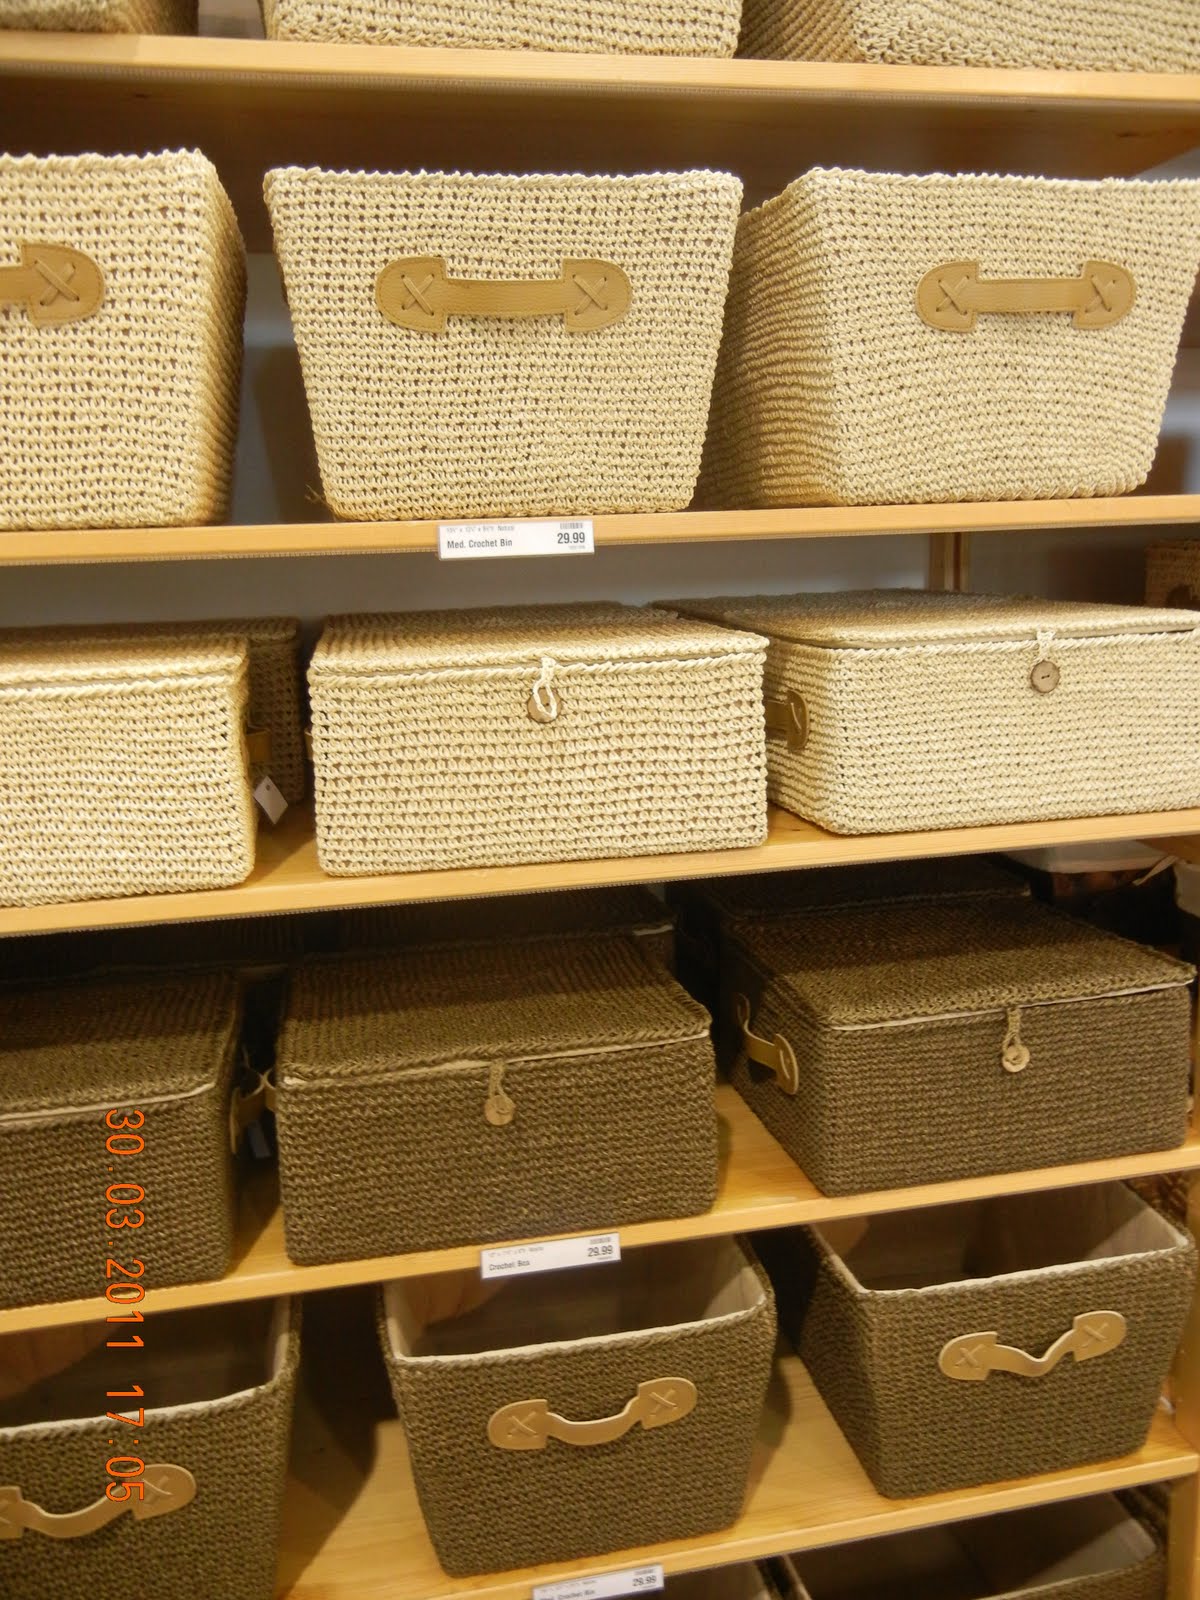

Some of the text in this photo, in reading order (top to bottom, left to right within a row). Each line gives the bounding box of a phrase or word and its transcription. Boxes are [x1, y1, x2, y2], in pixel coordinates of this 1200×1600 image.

[447, 538, 513, 549] Med. Crochet Bin
[557, 532, 586, 545] 29.99
[587, 1245, 614, 1258] 29.99
[488, 1260, 516, 1272] Crochet
[632, 1575, 657, 1587] 29.99
